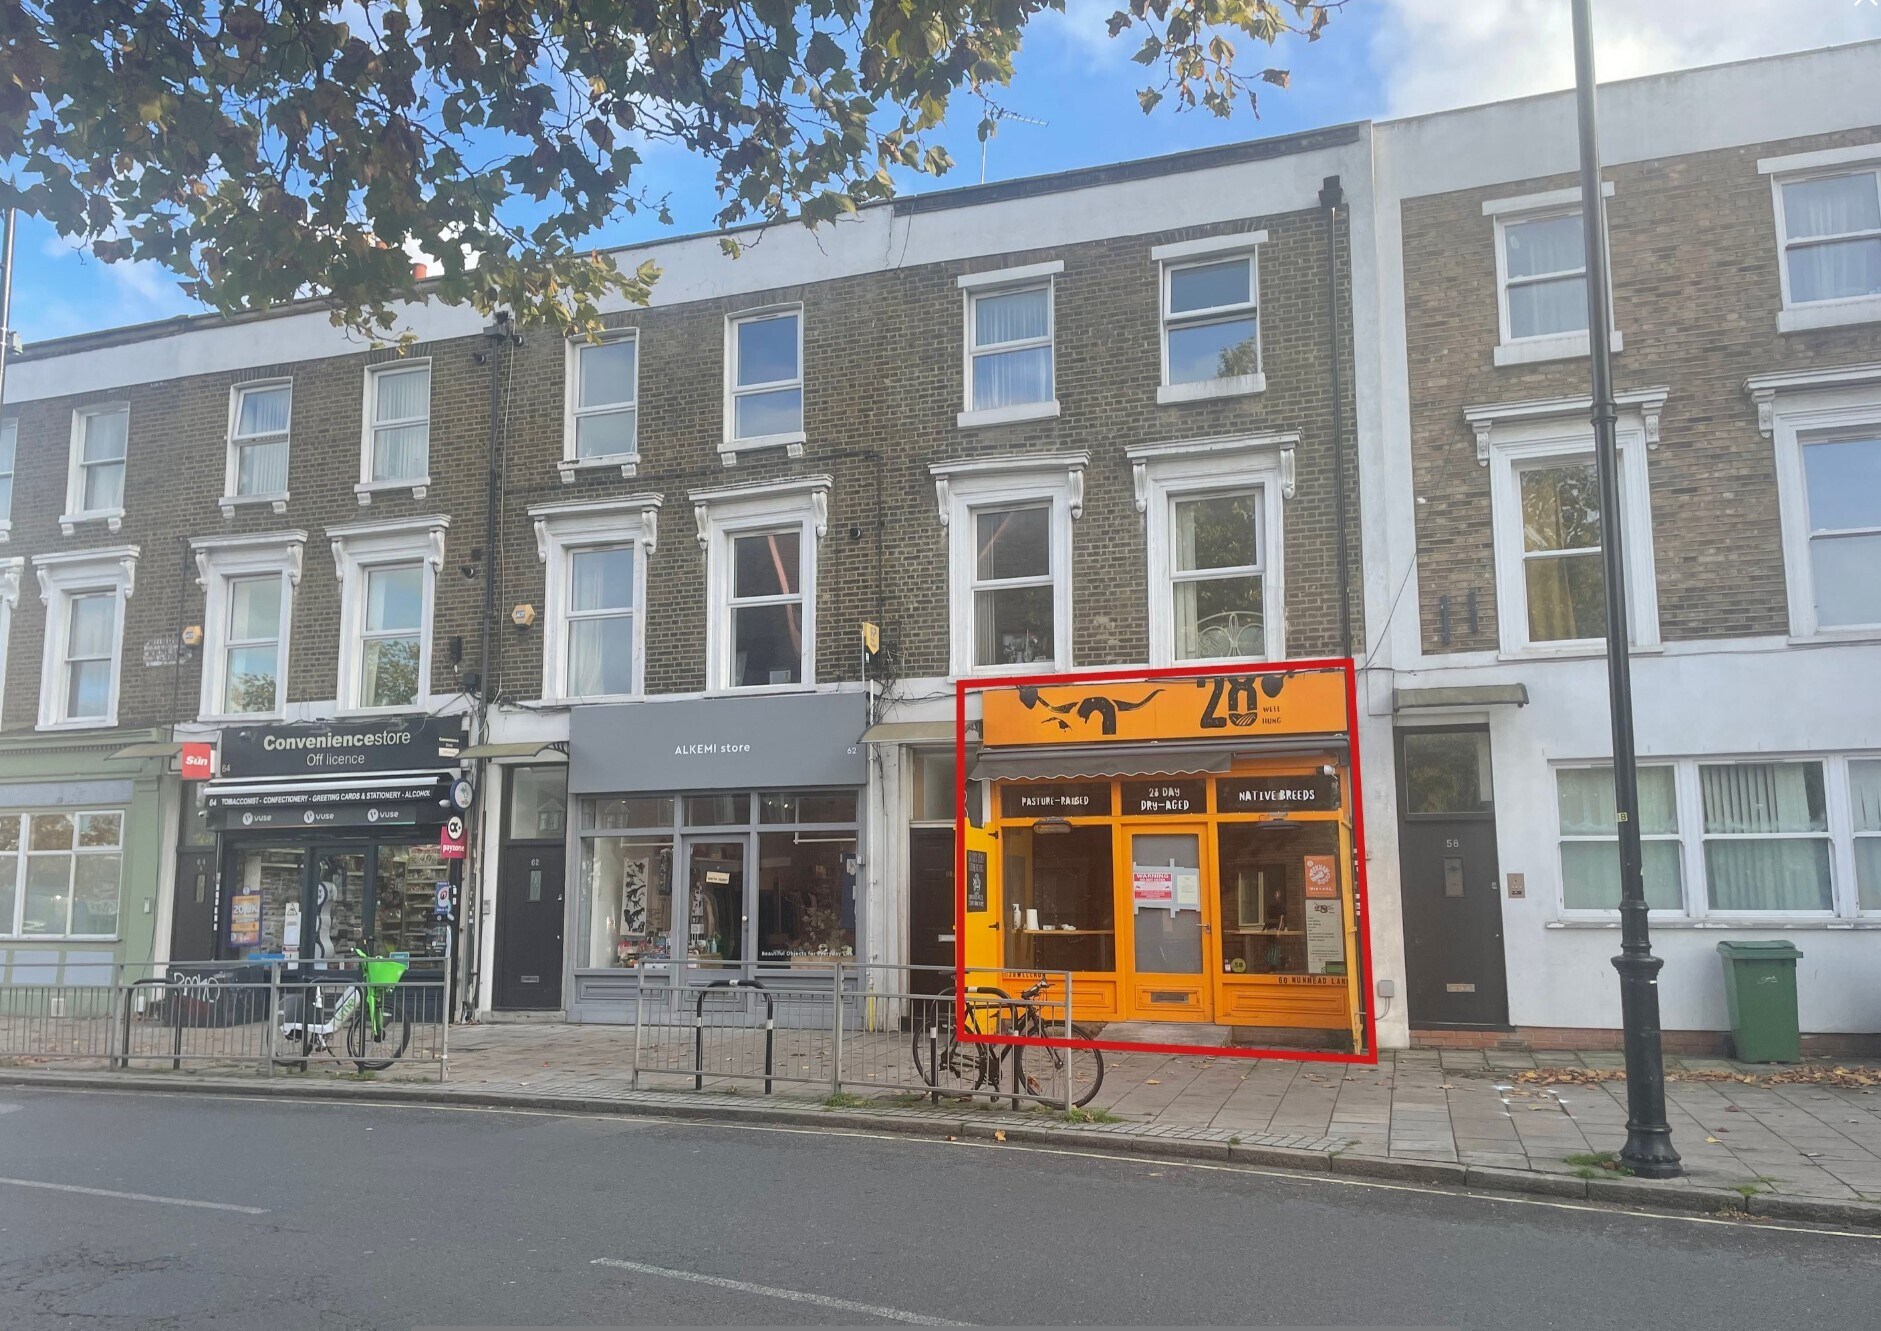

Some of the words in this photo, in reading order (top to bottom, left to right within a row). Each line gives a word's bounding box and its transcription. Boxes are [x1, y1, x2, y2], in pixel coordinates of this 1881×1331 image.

[1197, 677, 1257, 728] 28
[1262, 717, 1281, 725] HUNG
[674, 743, 717, 755] ALKEMI
[720, 744, 750, 753] store
[846, 747, 857, 755] 62
[306, 753, 323, 766] Off
[326, 753, 365, 766] licence
[221, 764, 231, 773] 64
[1148, 787, 1159, 797] 28
[1162, 787, 1180, 797] DAY
[1239, 790, 1276, 801] NATIVE
[1278, 789, 1315, 801] BREEDS
[208, 798, 217, 807] 64
[221, 797, 259, 806] TOBACCONIST
[263, 794, 308, 804] CONFECTIONERY
[312, 793, 340, 803] GREETING
[340, 792, 360, 801] CARDS
[361, 792, 366, 800] &
[366, 791, 401, 800] STATIONERY
[1021, 796, 1089, 807] PASTURE-RAISED
[1140, 800, 1190, 811] DRY-AGED
[254, 814, 272, 822] vuse
[315, 812, 335, 820] vuse
[379, 810, 399, 818] vuse
[1446, 839, 1459, 848] 58
[442, 844, 465, 854] payzone
[530, 858, 540, 866] 62
[1279, 976, 1288, 984] 60
[1291, 975, 1327, 985] NUNHEAD
[1331, 976, 1349, 985] LAN
